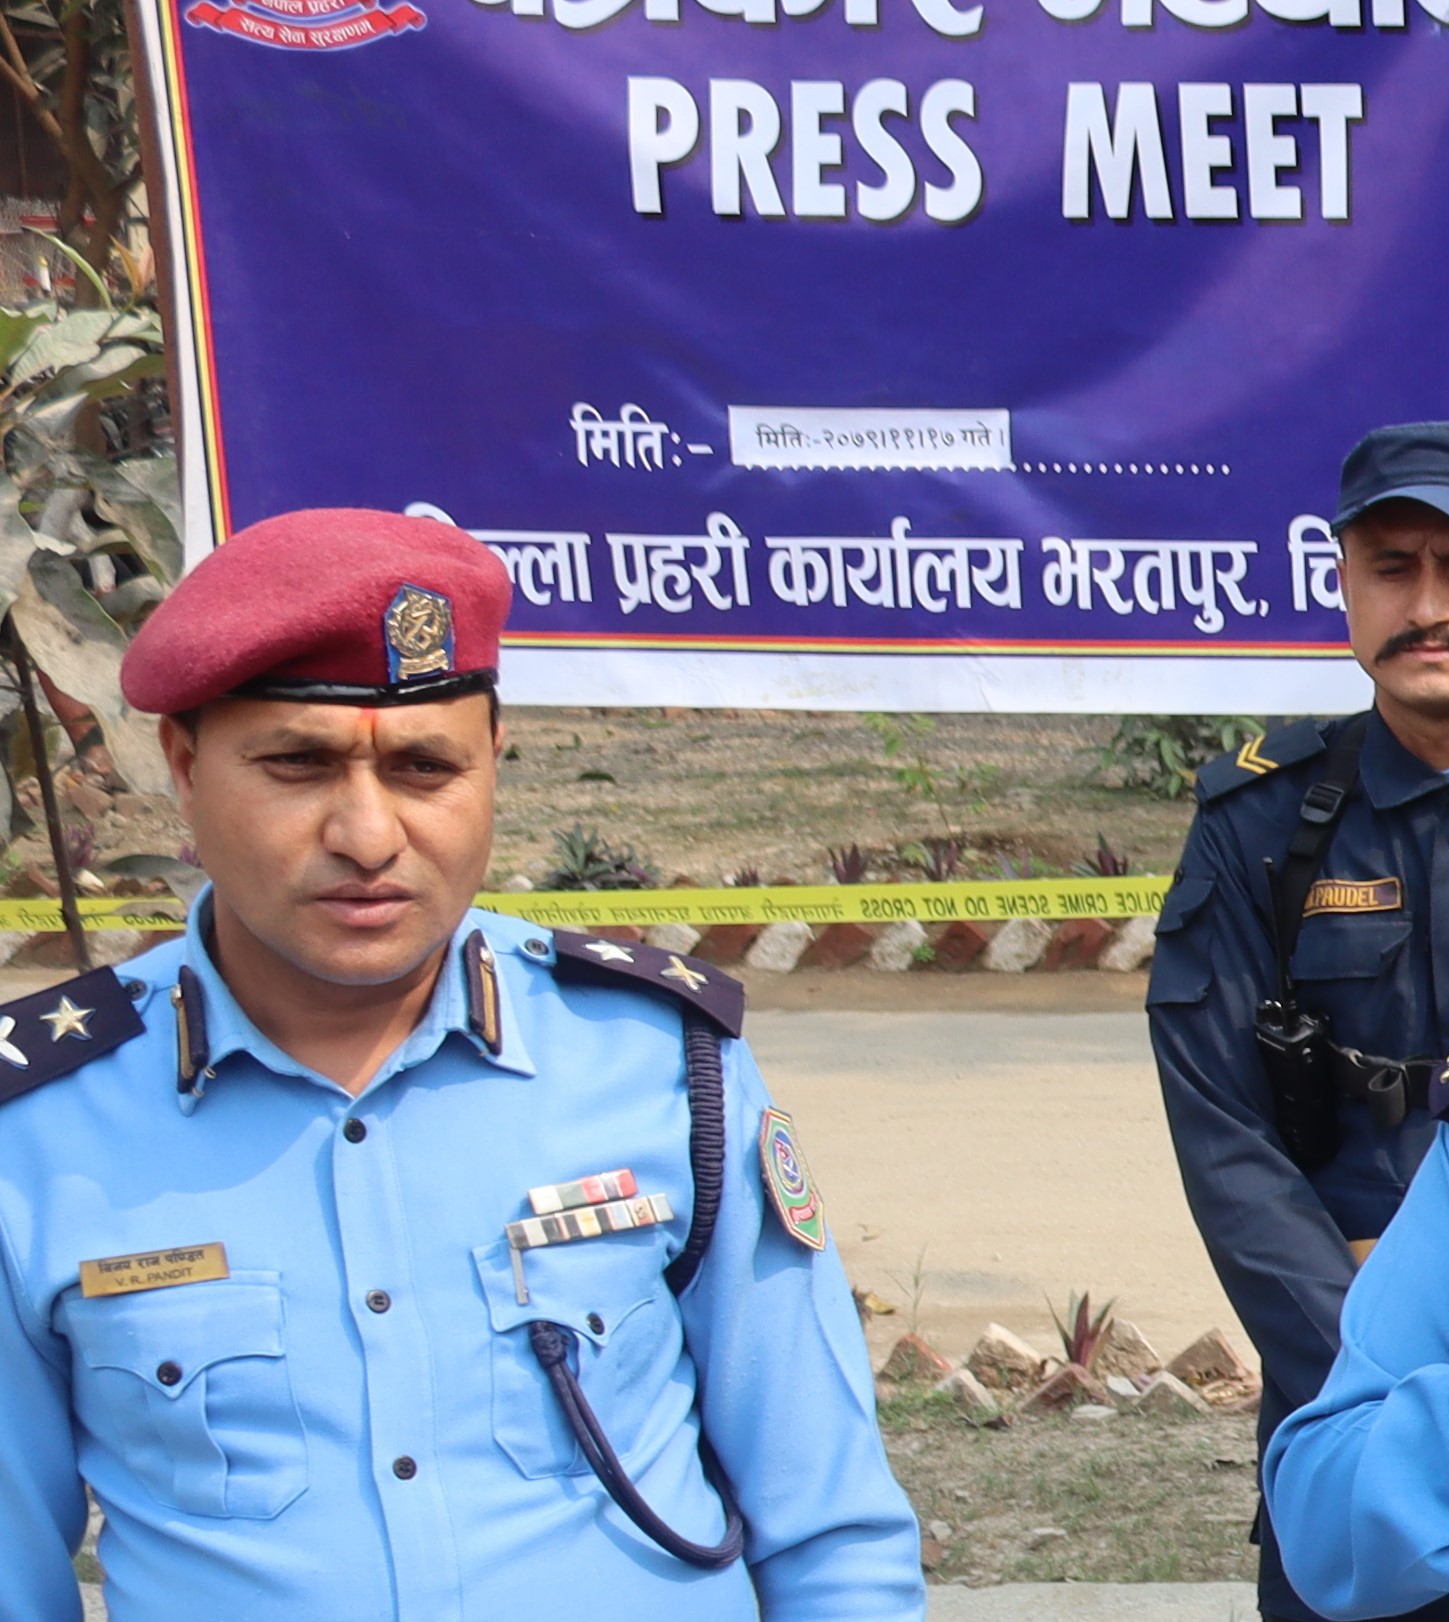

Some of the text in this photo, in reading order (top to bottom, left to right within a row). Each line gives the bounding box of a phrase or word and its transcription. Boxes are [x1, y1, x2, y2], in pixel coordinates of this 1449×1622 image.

[626, 76, 1364, 222] PRESS MEET
[606, 511, 749, 615] प्रहरी
[766, 515, 1023, 613] कार्यालय
[147, 1267, 192, 1282] PANDIT
